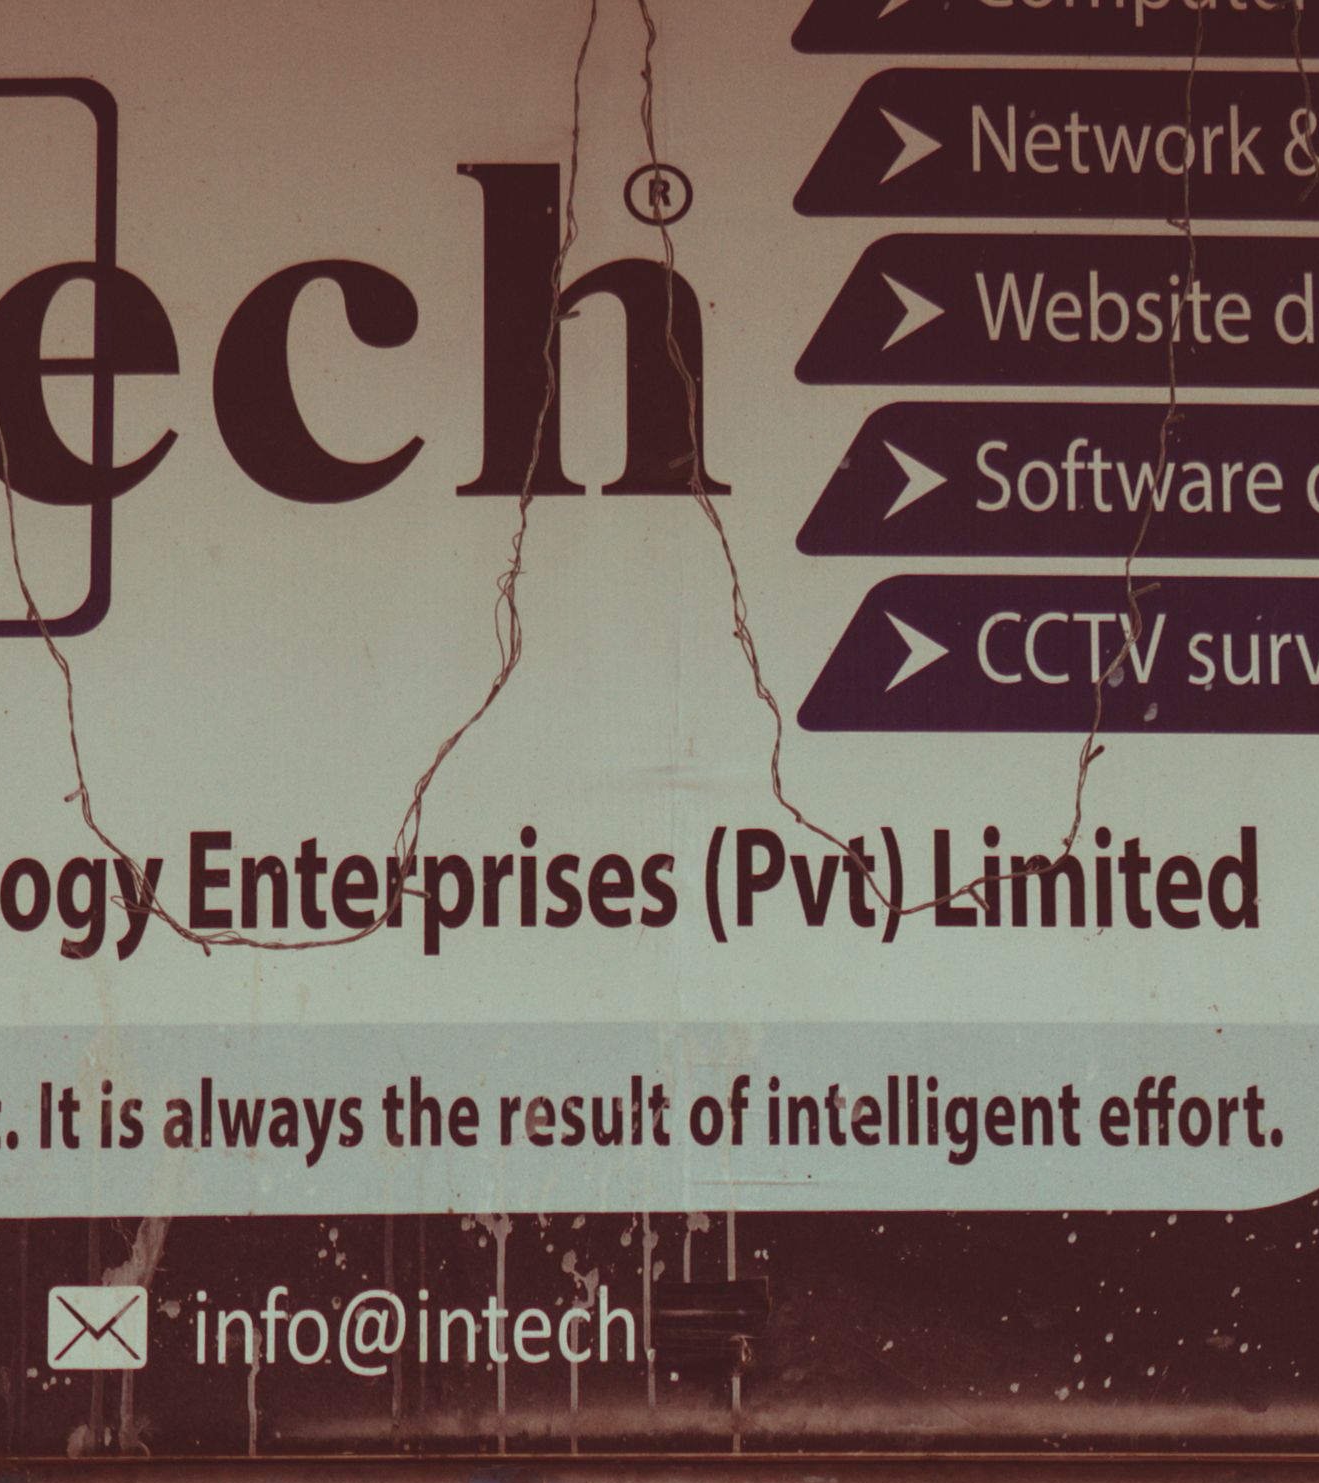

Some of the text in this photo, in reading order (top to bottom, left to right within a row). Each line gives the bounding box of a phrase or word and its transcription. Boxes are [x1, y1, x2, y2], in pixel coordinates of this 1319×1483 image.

[971, 104, 1265, 175] Network
[975, 269, 1252, 344] Website
[976, 437, 1284, 514] Software
[977, 611, 1167, 685] CCTV
[187, 825, 678, 955] Enterprises
[705, 825, 905, 943] (Pvt)
[934, 825, 1260, 930] Limited
[40, 1081, 81, 1150] It
[100, 1079, 145, 1150] is
[163, 1077, 364, 1168] always
[381, 1075, 480, 1148] the
[500, 1074, 671, 1148] result
[689, 1074, 751, 1147] of
[768, 1074, 1081, 1166] intelligent
[1099, 1075, 1284, 1148] effort.
